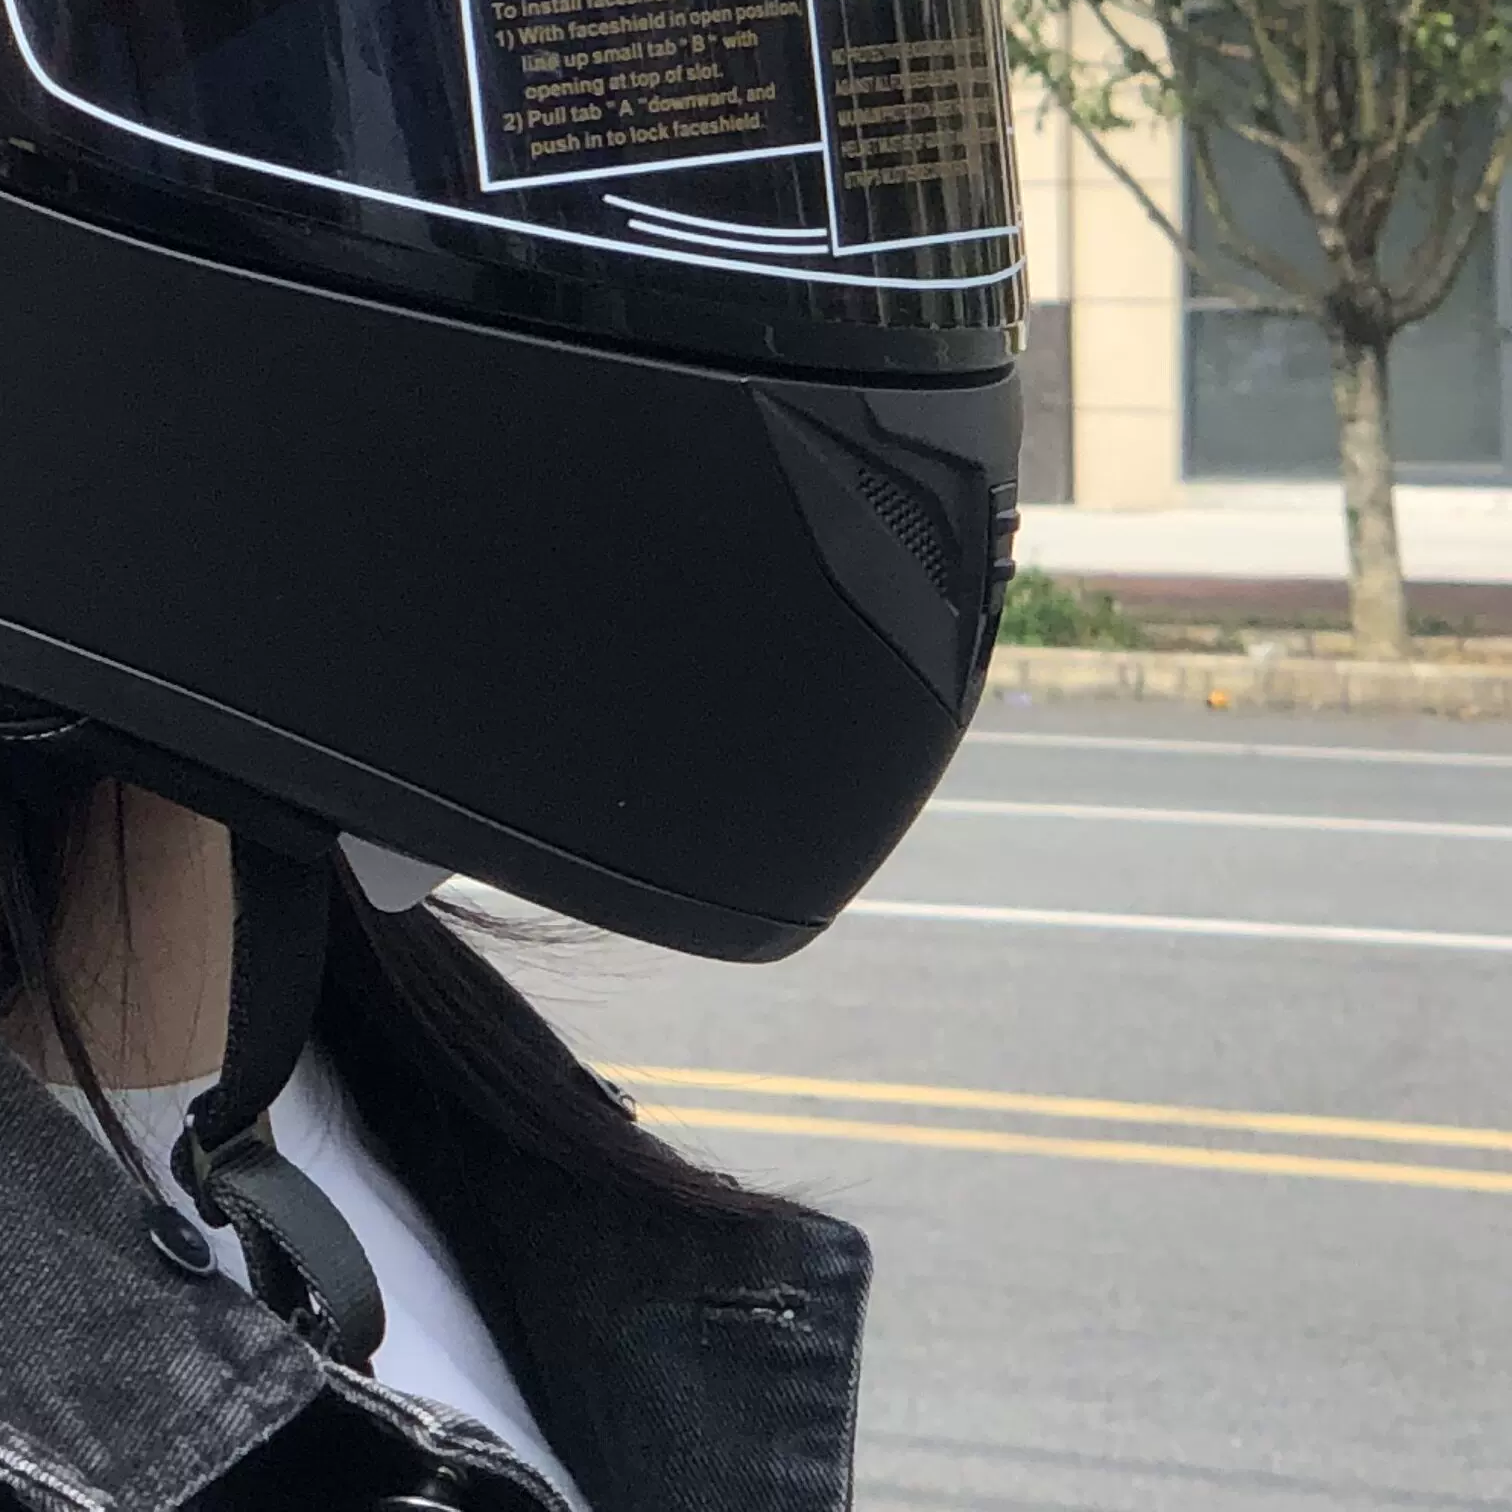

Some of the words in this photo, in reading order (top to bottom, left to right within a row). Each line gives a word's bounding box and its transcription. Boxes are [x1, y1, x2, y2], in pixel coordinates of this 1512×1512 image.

[491, 1, 517, 20] To
[494, 29, 514, 51] 1)
[517, 24, 565, 45] With
[568, 11, 666, 40] faceshield
[669, 9, 686, 28] in
[689, 7, 732, 29] open
[564, 53, 588, 71] up
[591, 42, 643, 65] small
[646, 39, 678, 59] tab
[722, 29, 759, 50] with
[524, 77, 605, 103] opening
[608, 72, 627, 91] at
[630, 71, 660, 89] top
[664, 64, 685, 84] of
[502, 111, 524, 135] 2)
[527, 105, 567, 129] Pull
[570, 102, 603, 123] tab
[746, 81, 776, 103] and
[530, 133, 581, 161] push
[584, 131, 603, 150] in
[606, 129, 627, 147] to
[629, 122, 670, 144] lock
